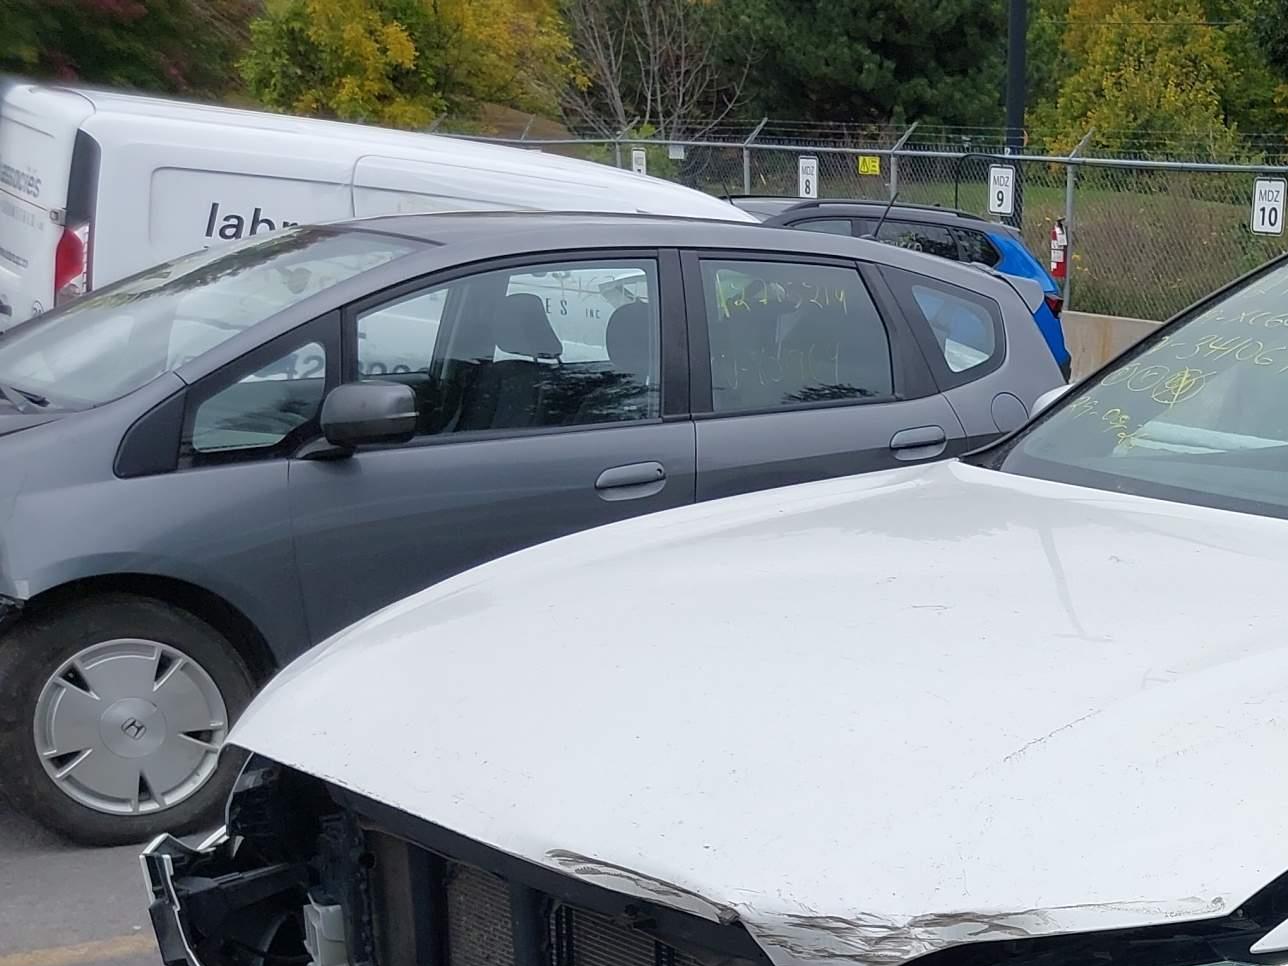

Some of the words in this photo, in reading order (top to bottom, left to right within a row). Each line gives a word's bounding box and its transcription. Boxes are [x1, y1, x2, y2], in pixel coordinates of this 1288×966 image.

[804, 179, 811, 195] 8
[992, 175, 1010, 187] MDZ
[996, 190, 1005, 208] 9
[1259, 189, 1280, 203] MDZ
[1259, 206, 1278, 227] 10
